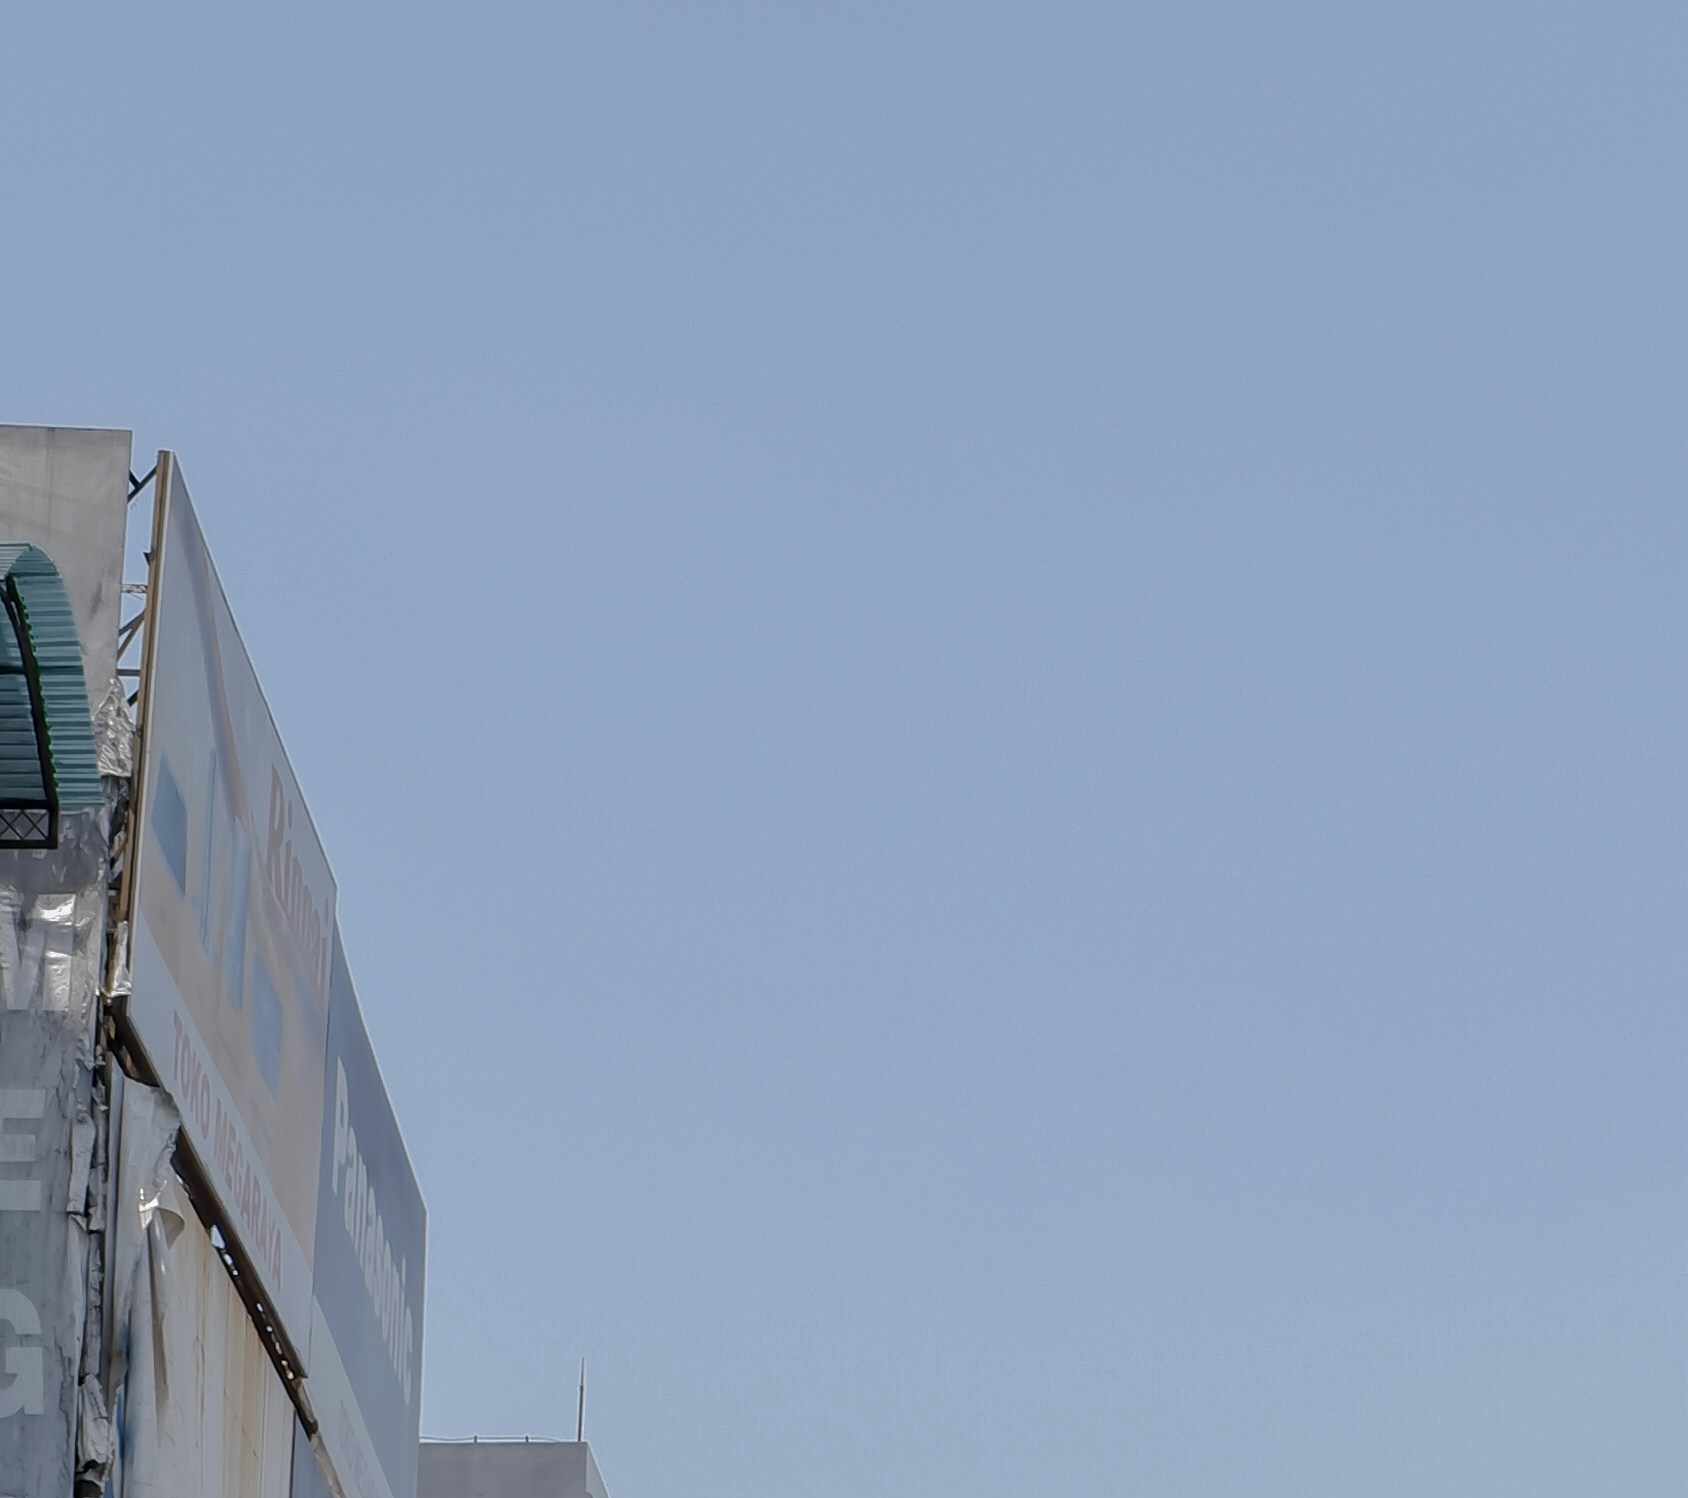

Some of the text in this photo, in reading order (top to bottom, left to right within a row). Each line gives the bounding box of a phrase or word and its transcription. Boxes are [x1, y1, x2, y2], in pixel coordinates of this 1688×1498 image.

[172, 1010, 282, 1294] TOKO MEGARAYA
[331, 1056, 415, 1404] Panasonic
